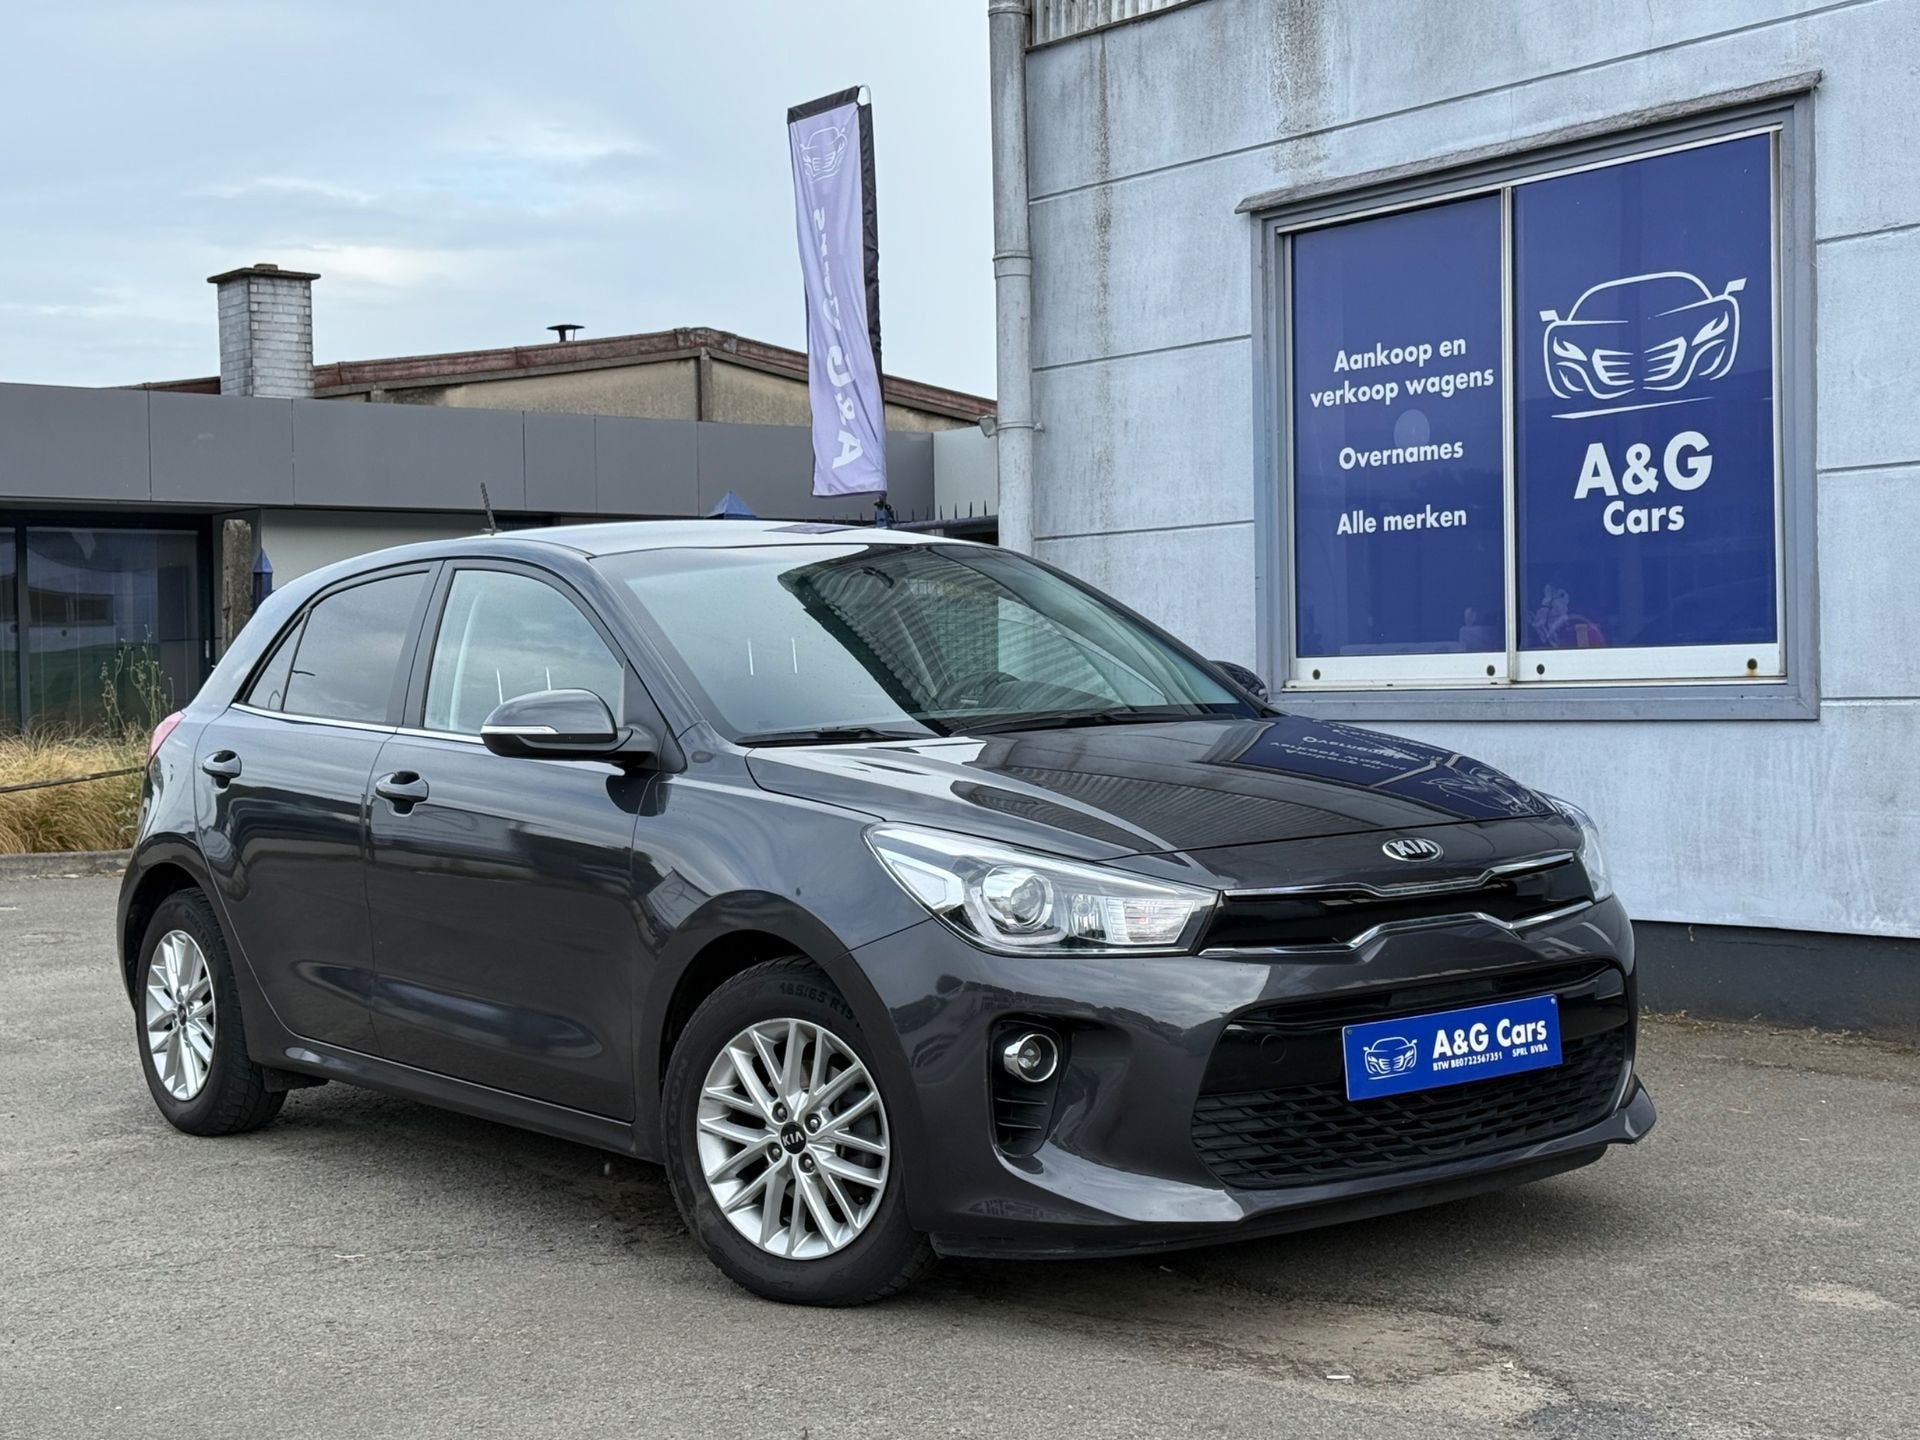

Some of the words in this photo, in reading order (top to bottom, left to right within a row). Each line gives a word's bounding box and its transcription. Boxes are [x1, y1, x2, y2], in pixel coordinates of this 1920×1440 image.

[1333, 342, 1433, 373] Aankoop
[1439, 338, 1466, 358] en
[1310, 380, 1399, 408] verkoop
[1405, 368, 1494, 398] wagens
[1338, 441, 1464, 470] Overnames
[1573, 430, 1713, 500] A&G
[1336, 509, 1377, 535] Alle
[1383, 504, 1467, 532] merken
[1603, 500, 1685, 536] Cars
[1389, 839, 1437, 856] KIA
[1432, 1022, 1489, 1059] A&G
[1496, 1018, 1548, 1047] Cars
[1432, 1059, 1450, 1072] BTW
[1512, 1046, 1528, 1058] SPRL
[1530, 1043, 1548, 1055] BVBA
[782, 1131, 804, 1146] KIA
